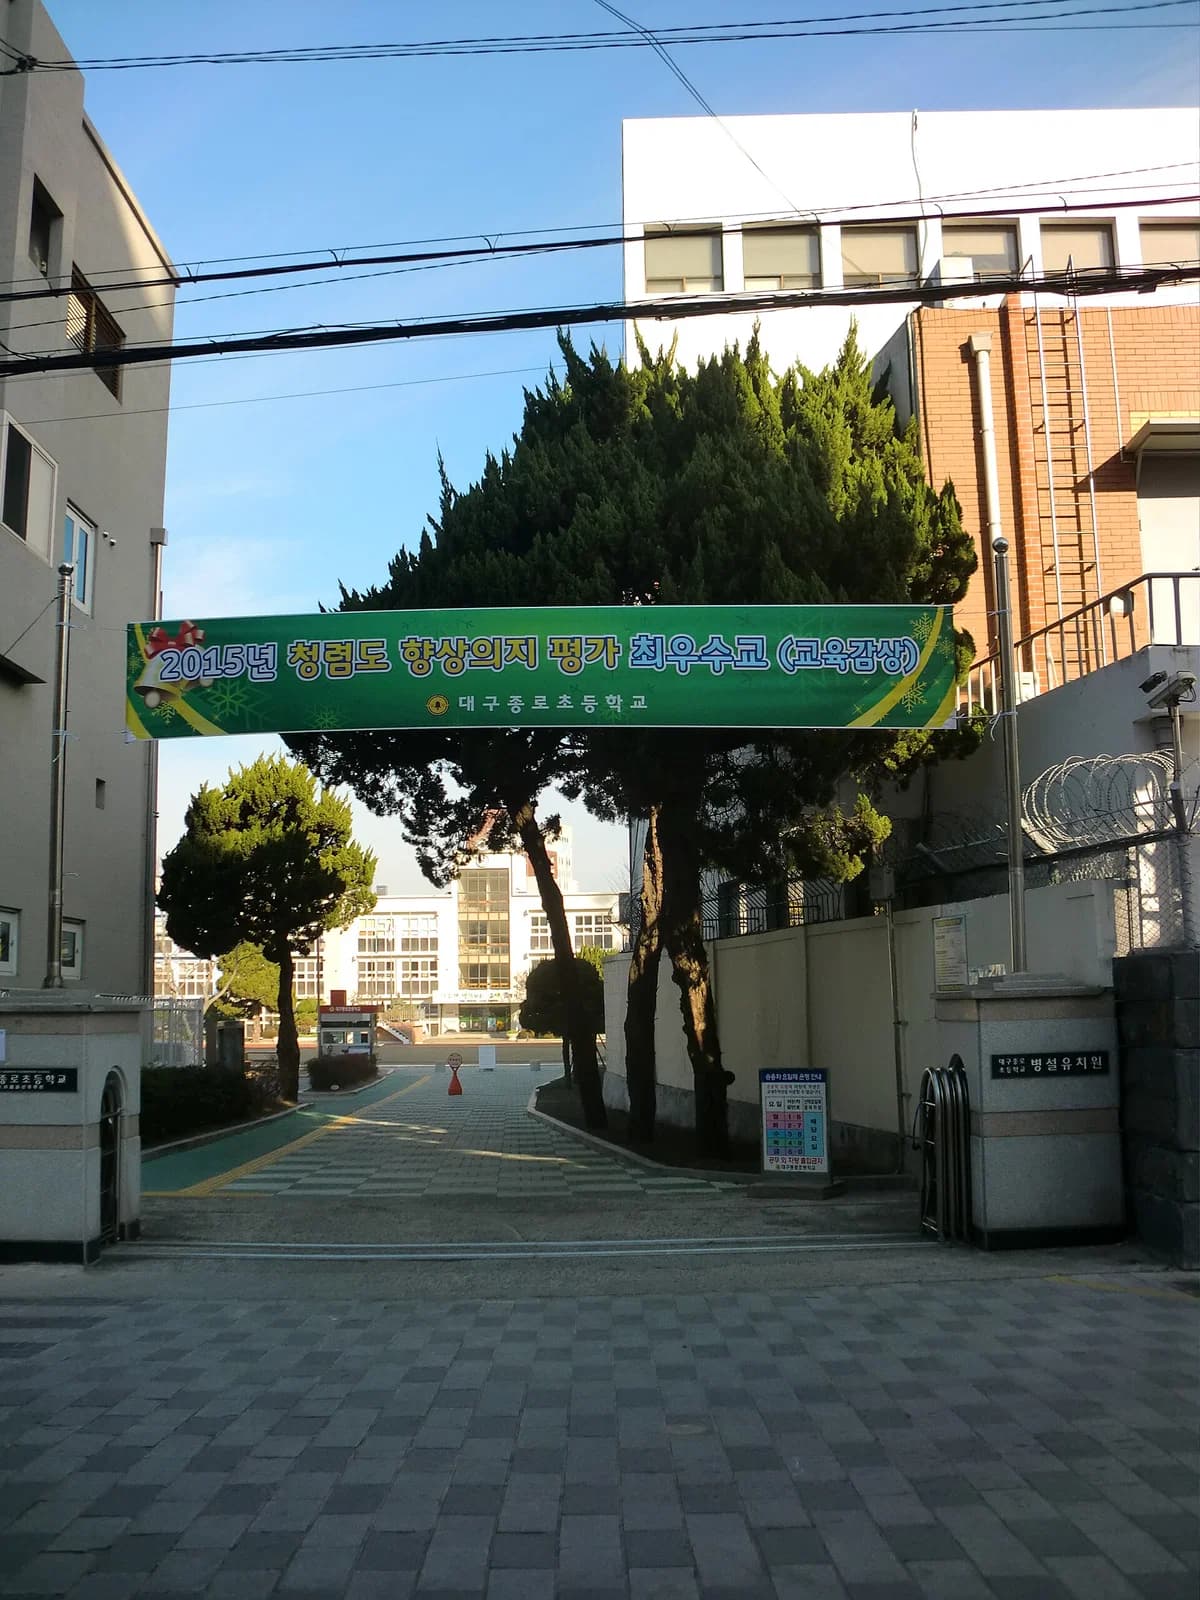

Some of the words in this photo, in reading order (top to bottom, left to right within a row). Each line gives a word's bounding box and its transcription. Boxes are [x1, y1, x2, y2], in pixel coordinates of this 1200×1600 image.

[159, 643, 277, 682] 2015년
[288, 639, 392, 681] 청렴도
[400, 635, 538, 677] 향상의지
[547, 635, 621, 676] 평가
[630, 633, 770, 676] 최우수교
[777, 635, 920, 676] (교육감상)
[1031, 1056, 1103, 1072] 병설유치원
